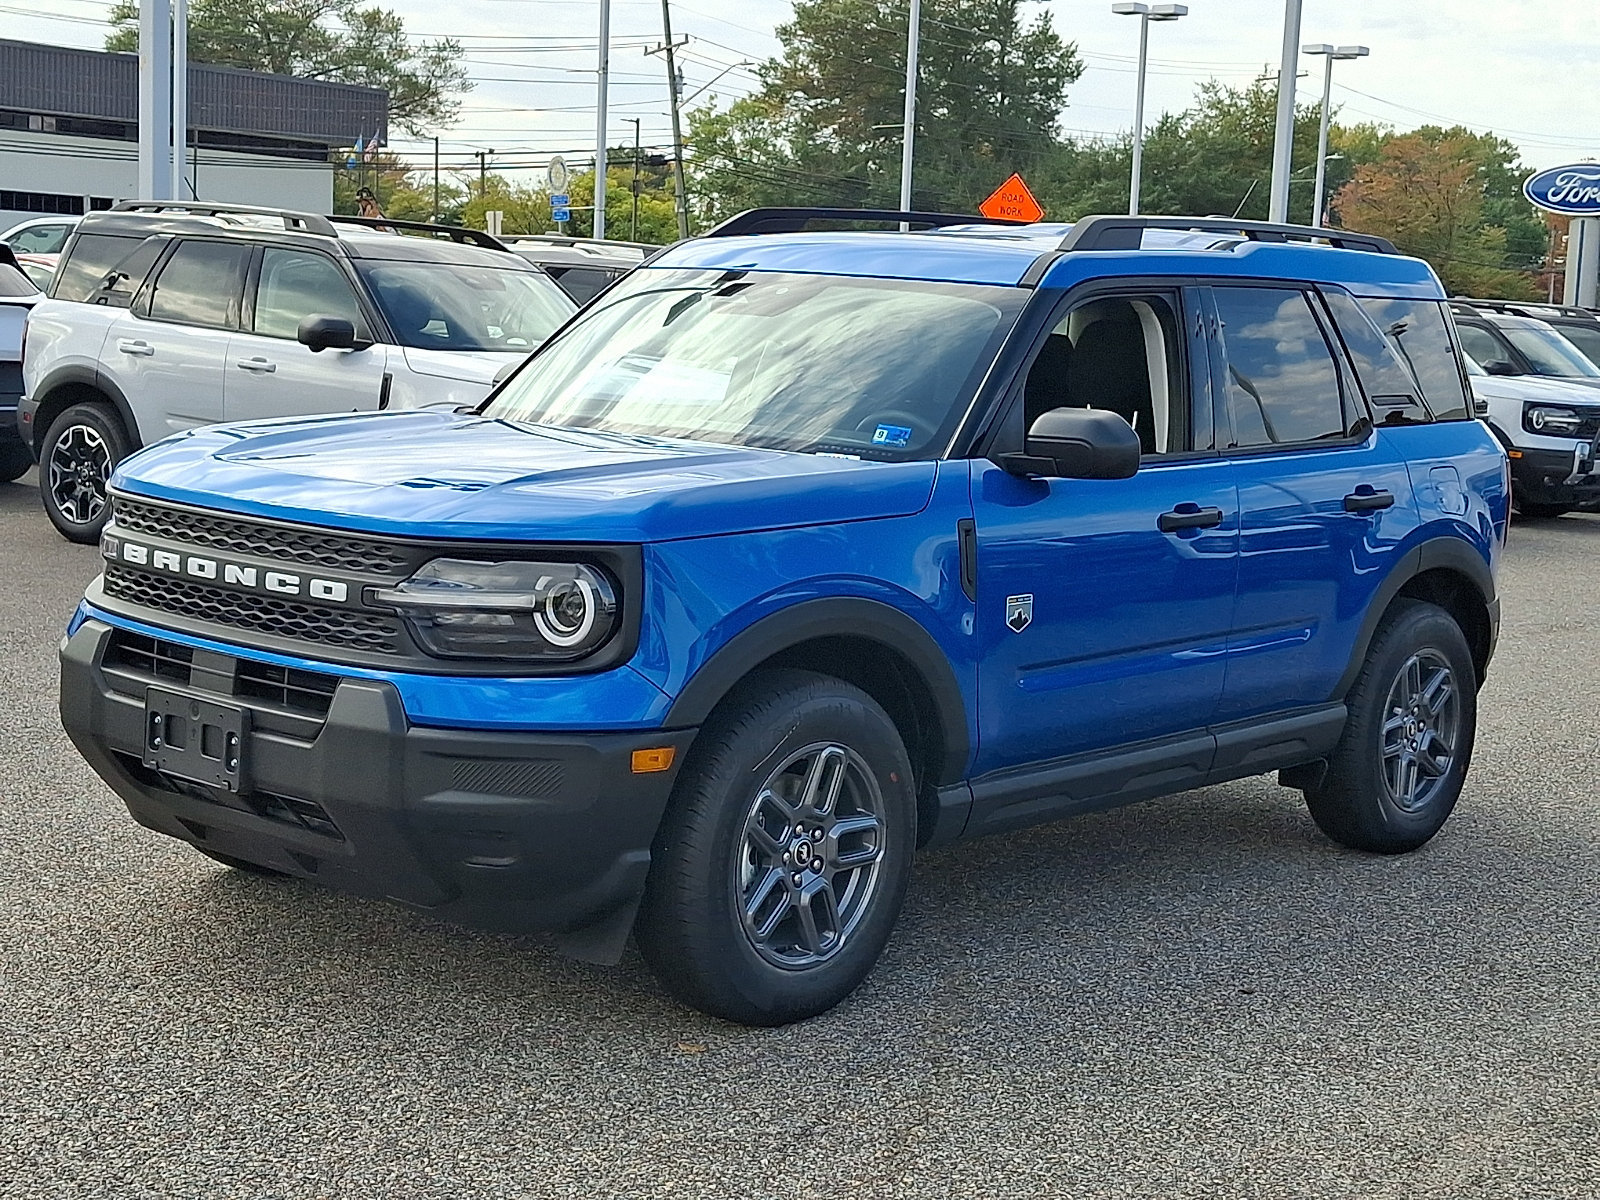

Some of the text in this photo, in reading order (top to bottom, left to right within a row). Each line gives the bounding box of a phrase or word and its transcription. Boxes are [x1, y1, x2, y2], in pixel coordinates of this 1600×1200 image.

[1547, 172, 1600, 203] For
[1001, 193, 1025, 203] ROAD
[1000, 206, 1023, 216] WORK
[876, 430, 885, 439] 9
[123, 542, 348, 602] BRONCO
